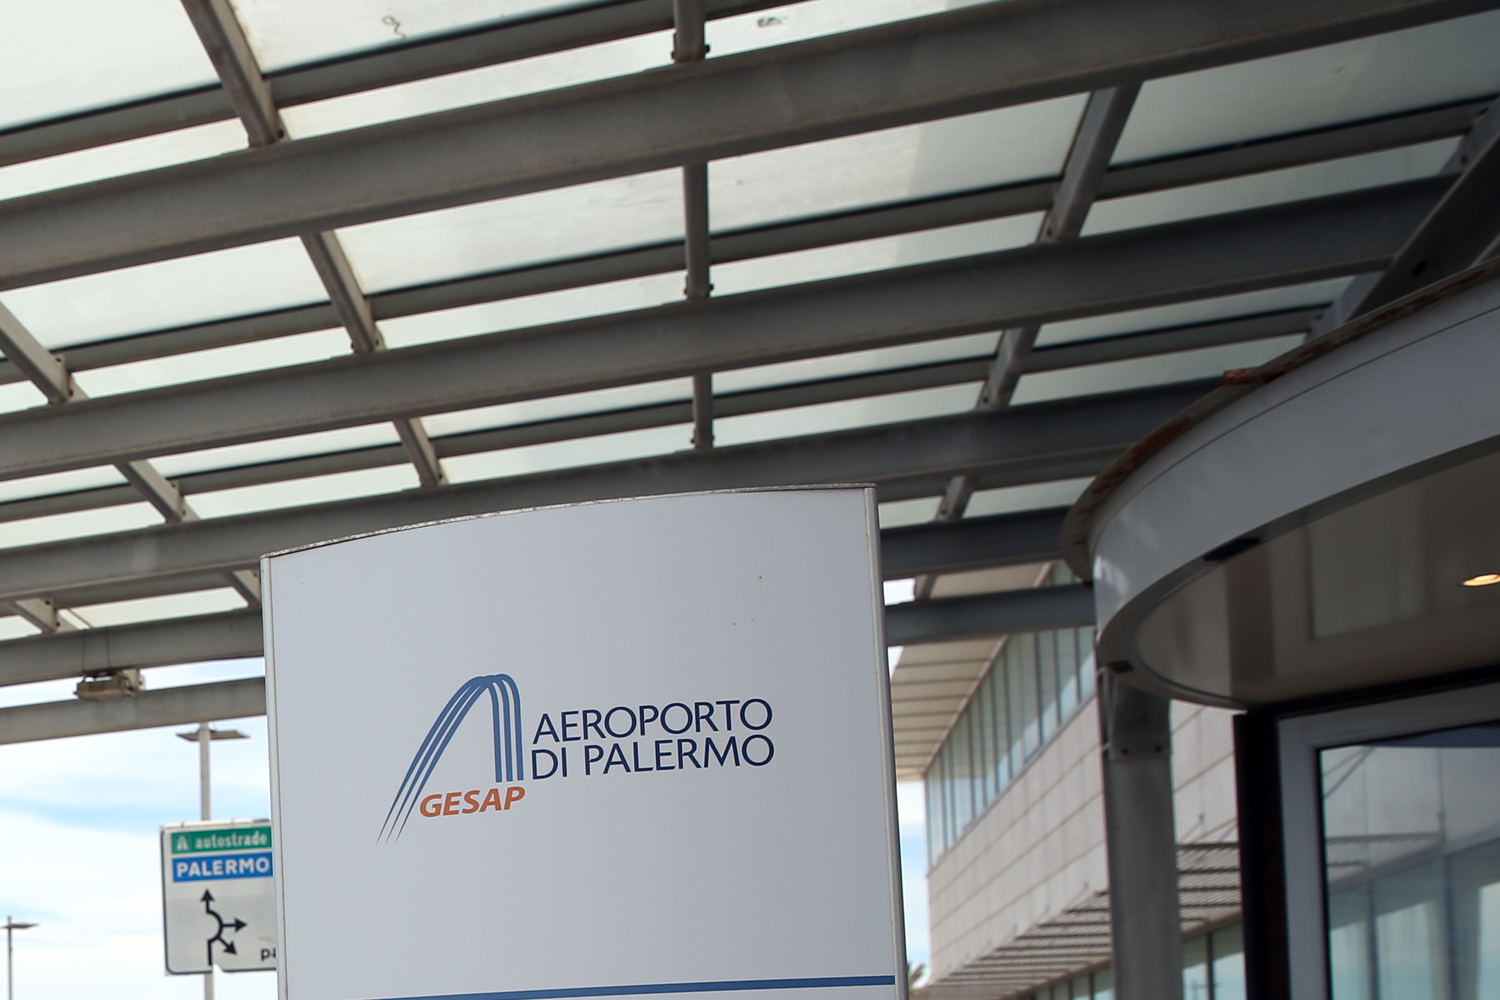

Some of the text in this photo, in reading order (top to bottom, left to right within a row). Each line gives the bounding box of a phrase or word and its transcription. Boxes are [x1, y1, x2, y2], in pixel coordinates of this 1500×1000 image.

[532, 698, 773, 744] AEROPORTO
[531, 734, 775, 780] DI PALERMO
[419, 786, 526, 818] GESAP
[195, 830, 268, 849] autostrade
[176, 857, 270, 878] PALERMO
